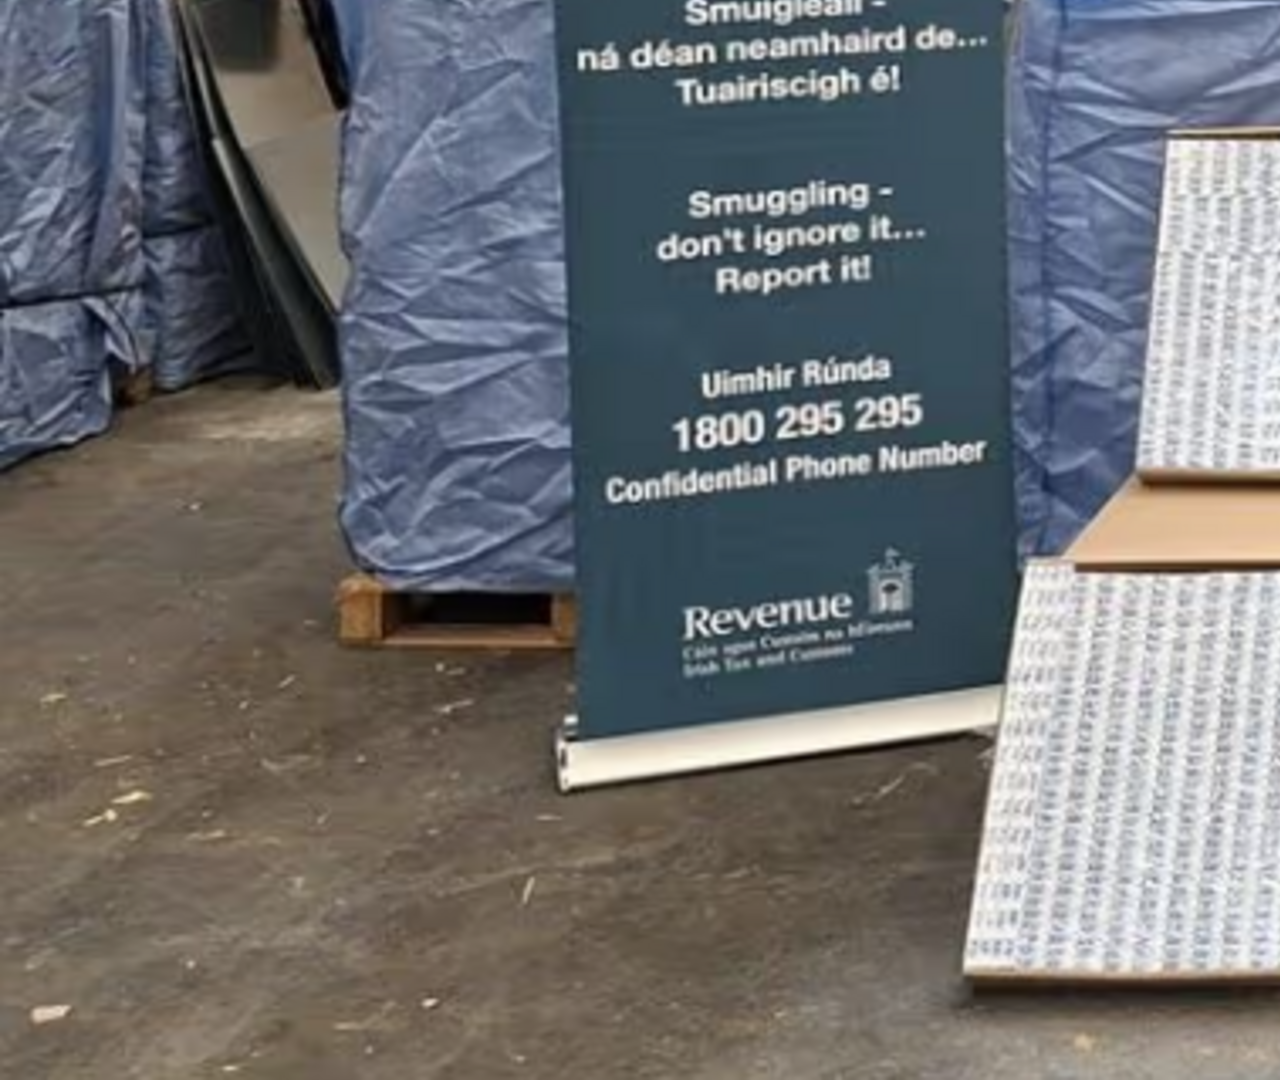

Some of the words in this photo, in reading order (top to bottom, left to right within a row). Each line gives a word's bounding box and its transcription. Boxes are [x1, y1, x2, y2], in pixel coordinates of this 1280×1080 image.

[578, 44, 619, 70] ná
[630, 44, 716, 68] déan
[727, 27, 906, 62] neamhaird
[915, 25, 987, 49] de...
[676, 69, 860, 104] Tuairiscigh
[870, 65, 899, 91] é!
[688, 181, 870, 219] Smuggling
[657, 229, 744, 260] don't
[754, 224, 860, 254] ignore
[870, 216, 924, 239] it...
[716, 260, 830, 294] Report
[841, 255, 870, 281] it!
[702, 363, 795, 398] Uimhir
[803, 356, 891, 386] Rúnda
[674, 410, 764, 451] 1800
[776, 402, 844, 439] 295
[855, 394, 922, 430] 295
[606, 460, 777, 503] Confidential
[786, 454, 871, 481] Phone
[879, 441, 986, 471] Number
[682, 592, 853, 641] Revenue
